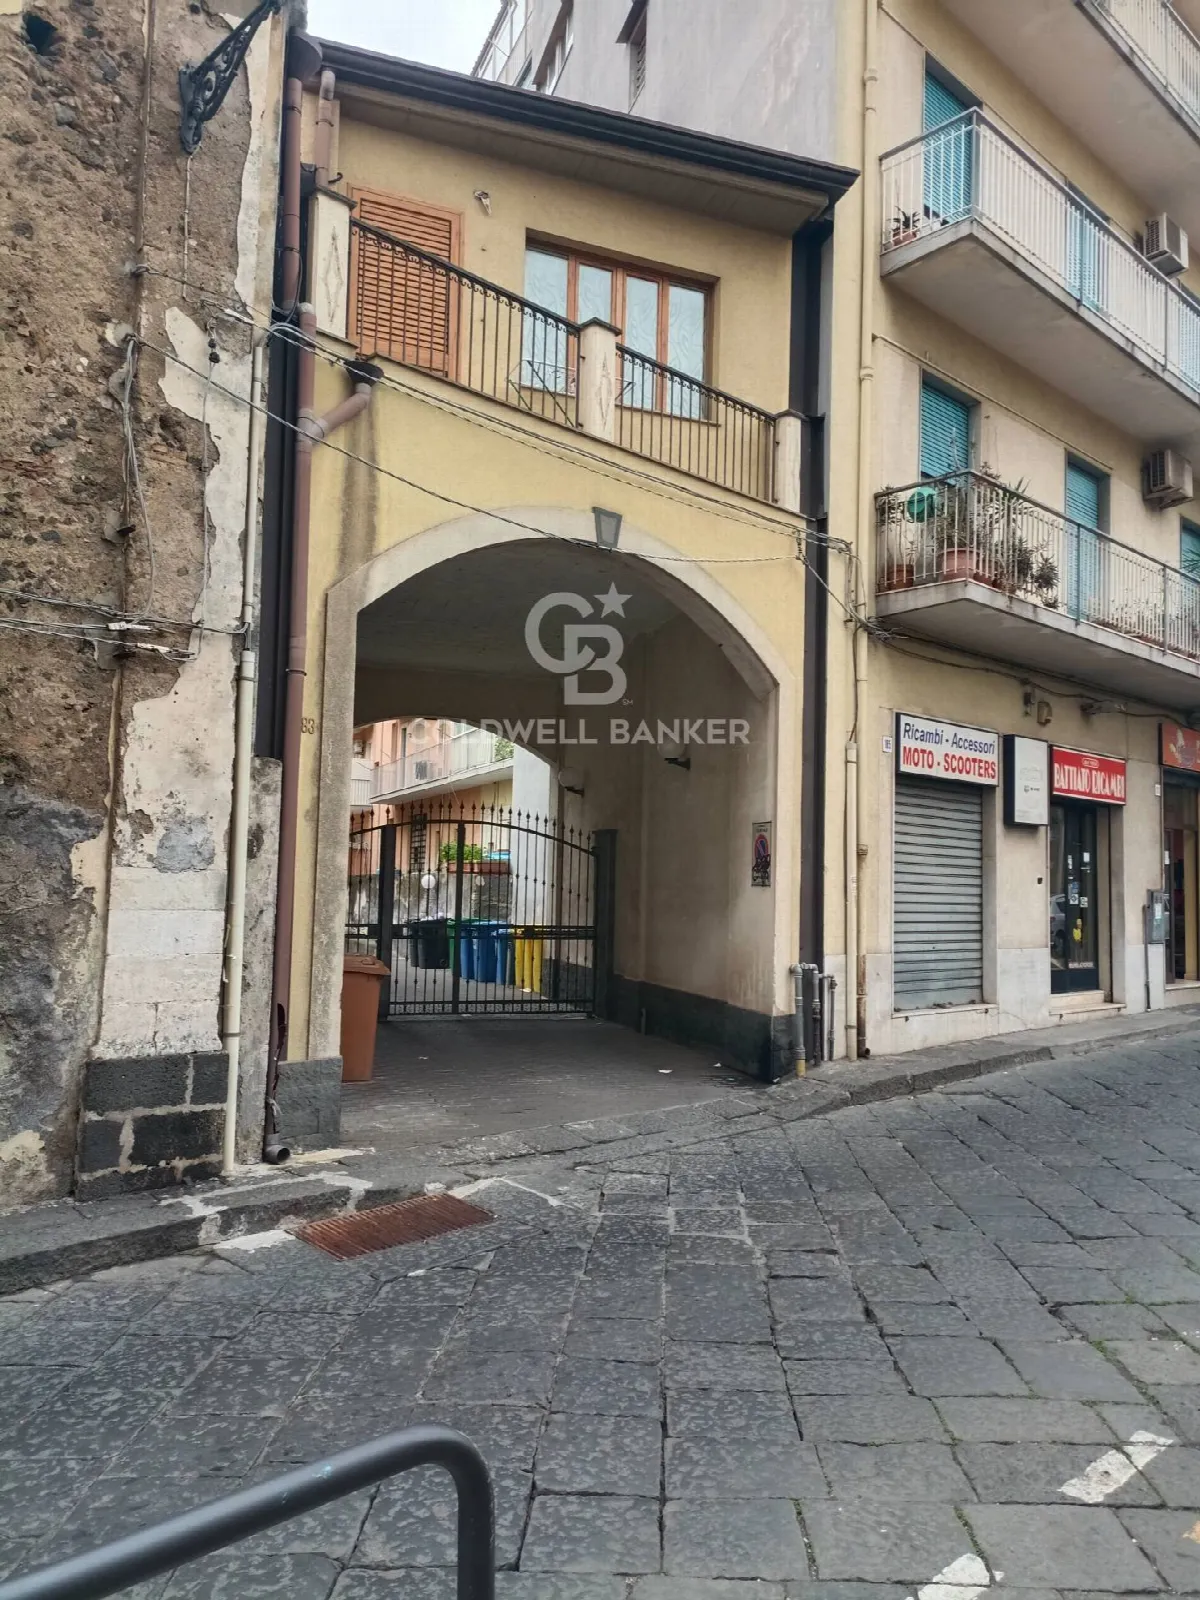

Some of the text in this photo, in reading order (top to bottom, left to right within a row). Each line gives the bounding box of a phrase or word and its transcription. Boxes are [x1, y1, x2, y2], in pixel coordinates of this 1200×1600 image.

[903, 722, 944, 745] Ricambi
[951, 732, 996, 755] Accessori
[902, 746, 934, 769] MOTO
[943, 752, 996, 780] SCOOTERS
